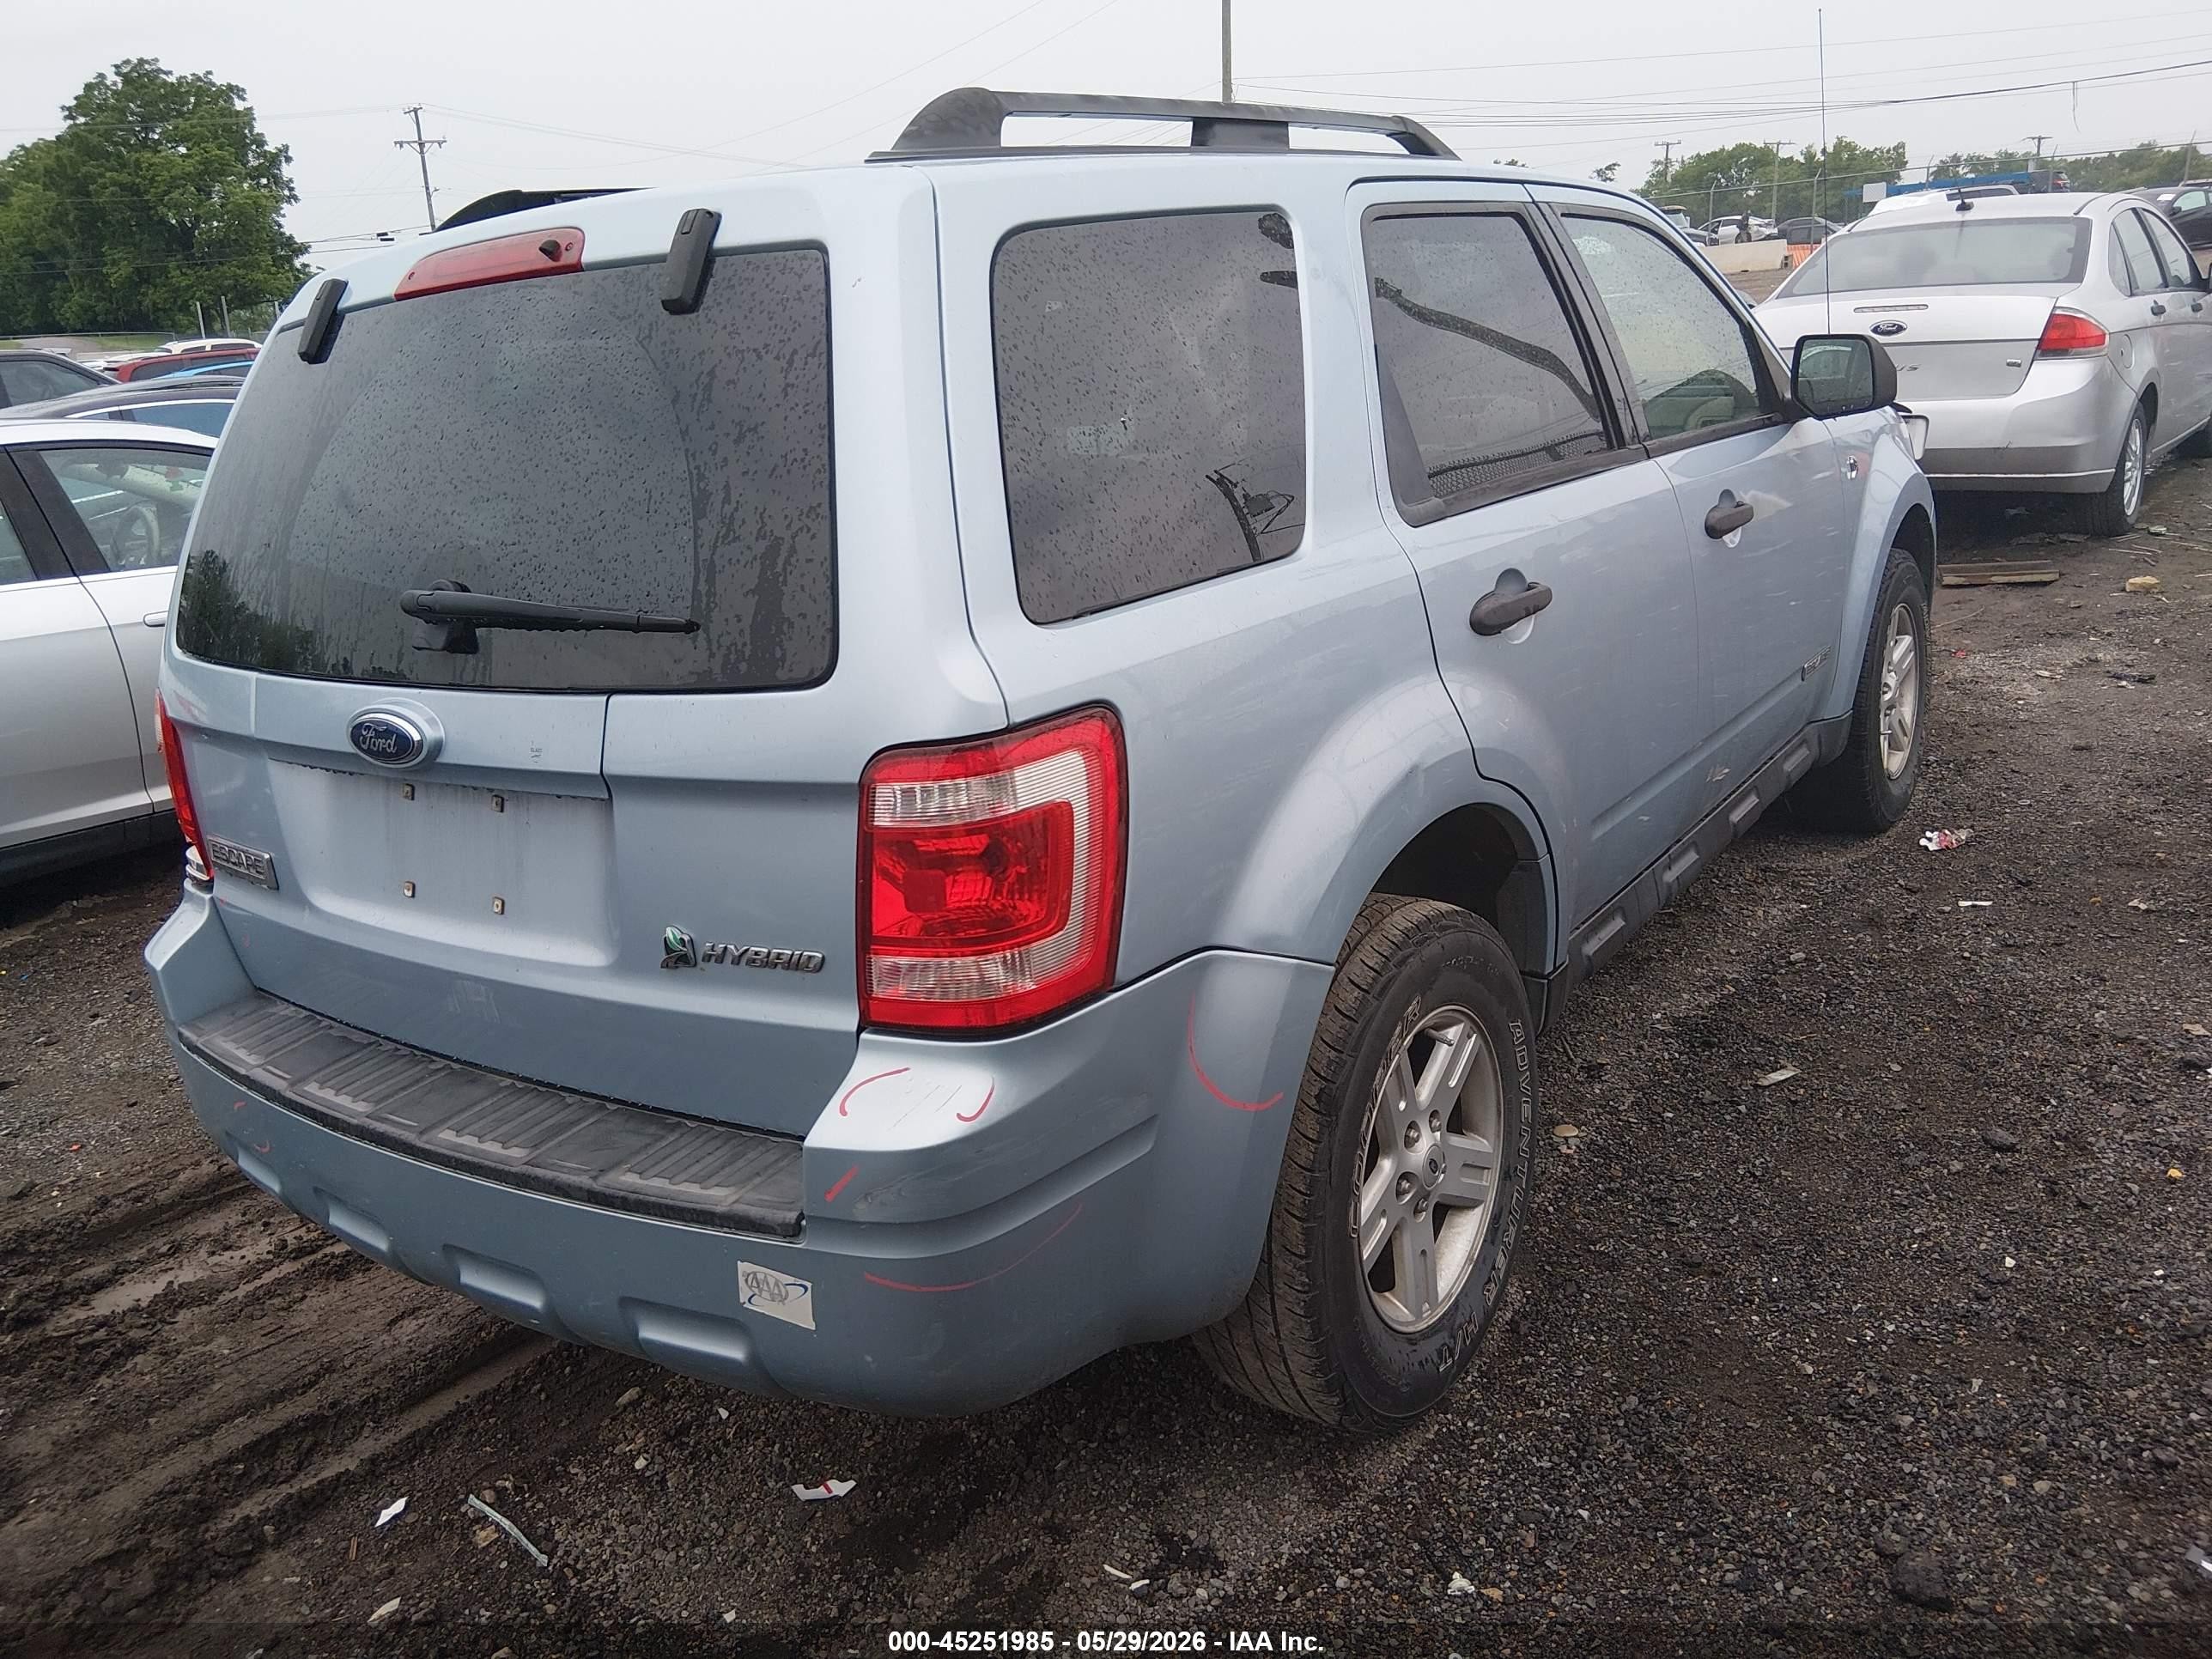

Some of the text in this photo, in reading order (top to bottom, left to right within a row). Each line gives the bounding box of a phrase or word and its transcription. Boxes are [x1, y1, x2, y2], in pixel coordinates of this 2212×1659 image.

[359, 722, 398, 753] Ford
[211, 842, 267, 878] ESCAPE
[701, 941, 826, 974] HYBRID
[1449, 1018, 1533, 1306] ADVENTURER
[749, 1273, 784, 1303] AAA
[1438, 1311, 1480, 1373] H/T
